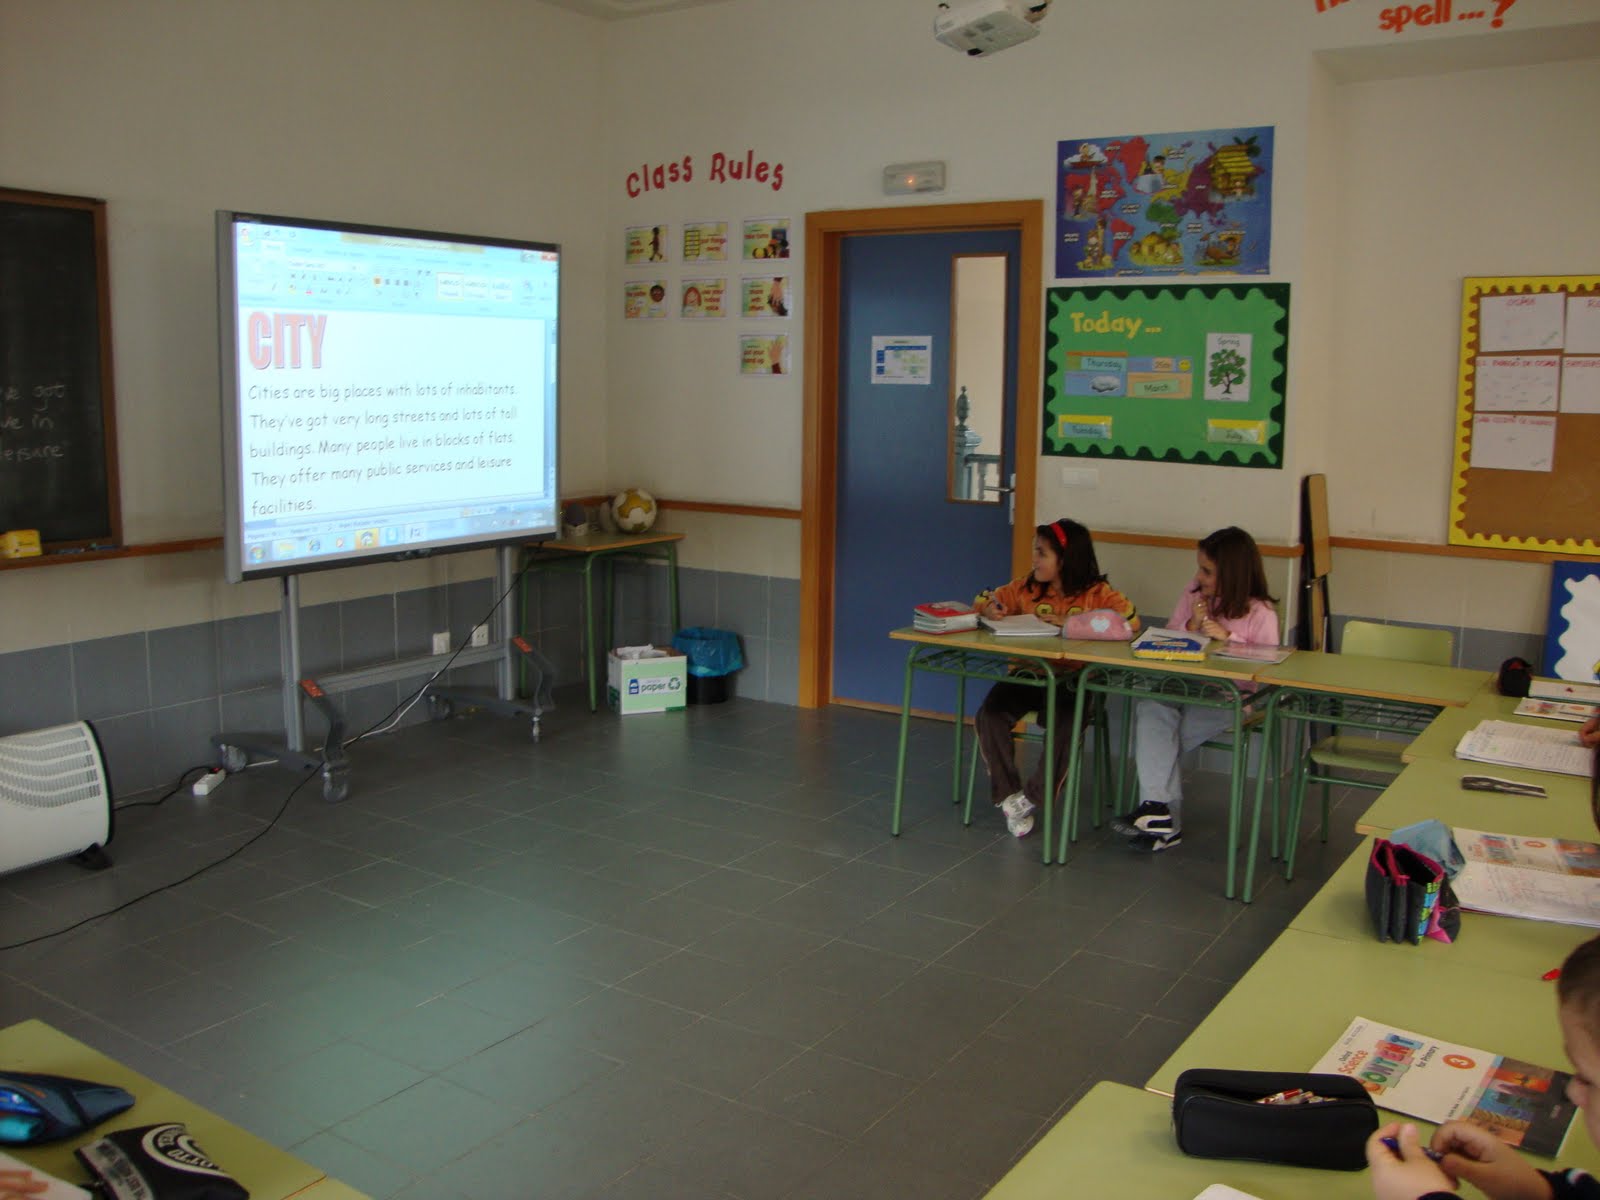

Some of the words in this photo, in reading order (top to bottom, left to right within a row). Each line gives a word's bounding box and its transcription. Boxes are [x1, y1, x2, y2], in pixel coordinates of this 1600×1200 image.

[626, 155, 692, 199] Class
[709, 150, 784, 191] Rules
[248, 311, 328, 370] CITY
[1217, 336, 1240, 347] Spring
[1087, 358, 1122, 371] Thursday
[248, 385, 289, 400] Cities
[294, 388, 315, 399] are
[320, 384, 339, 402] big
[344, 383, 382, 401] places
[387, 384, 411, 397] with
[416, 382, 437, 396] lots
[441, 382, 452, 396] of
[1143, 384, 1168, 392] March
[250, 414, 303, 432] They've
[307, 413, 328, 432] got
[334, 415, 360, 429] very
[365, 410, 388, 428] long
[393, 411, 436, 423] streets
[440, 411, 458, 421] and
[463, 408, 482, 420] lots
[486, 406, 496, 420] of
[501, 406, 517, 419] tall
[319, 440, 351, 456] Many
[357, 436, 395, 456] people
[400, 435, 418, 448] live
[423, 438, 433, 448] in
[436, 433, 470, 447] blocks
[473, 431, 484, 444] of
[252, 472, 285, 488] They
[290, 467, 327, 483] offer
[332, 468, 363, 484] many
[367, 461, 402, 478] public
[406, 461, 452, 475] services
[455, 457, 474, 471] and
[477, 456, 512, 470] leisure
[641, 683, 666, 693] paper
[1337, 1049, 1369, 1075] Science
[1420, 1046, 1440, 1063] Primary
[1449, 1056, 1467, 1066] 3
[1415, 1060, 1426, 1068] for
